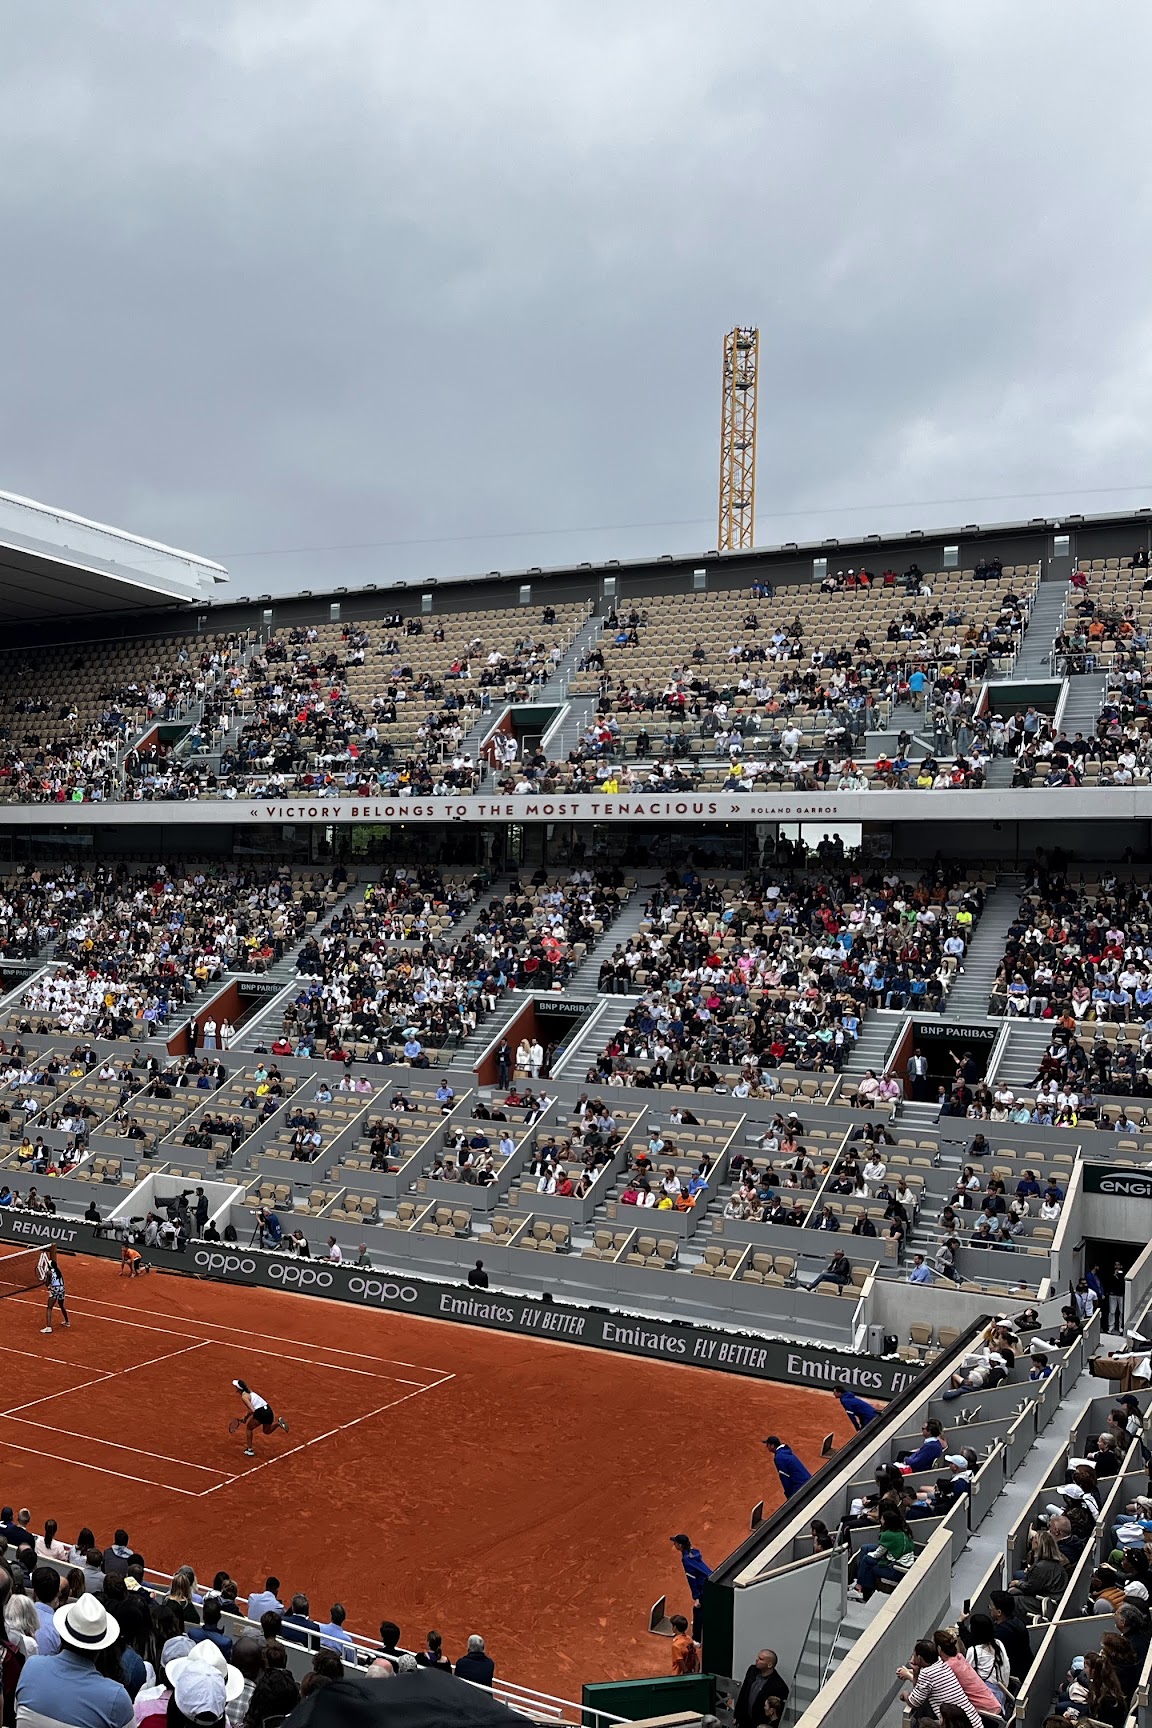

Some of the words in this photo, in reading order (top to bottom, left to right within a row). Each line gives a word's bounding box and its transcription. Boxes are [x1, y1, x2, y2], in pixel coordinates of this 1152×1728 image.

[266, 807, 341, 818] VICTORY
[351, 806, 434, 817] BELONGS
[445, 805, 467, 816] TO
[478, 804, 514, 816] THE
[526, 804, 580, 815] MOST
[591, 802, 718, 815] TENACIOUS
[241, 983, 256, 991] BNP
[539, 1002, 558, 1011] BNP
[559, 1004, 592, 1013] PARIBA
[920, 1026, 944, 1036] BNP
[946, 1027, 995, 1039] PARIBAS
[12, 1220, 78, 1242] RENAULT
[194, 1250, 256, 1274] oppo
[267, 1263, 334, 1287] oppo
[348, 1277, 418, 1303] oppo
[439, 1293, 514, 1323] Emirates
[519, 1307, 542, 1327] FLY
[541, 1311, 586, 1336] BETTER
[602, 1321, 686, 1354] Emirates
[693, 1338, 717, 1358] FLY
[718, 1342, 768, 1369] BETTER
[787, 1353, 883, 1389] Emirates
